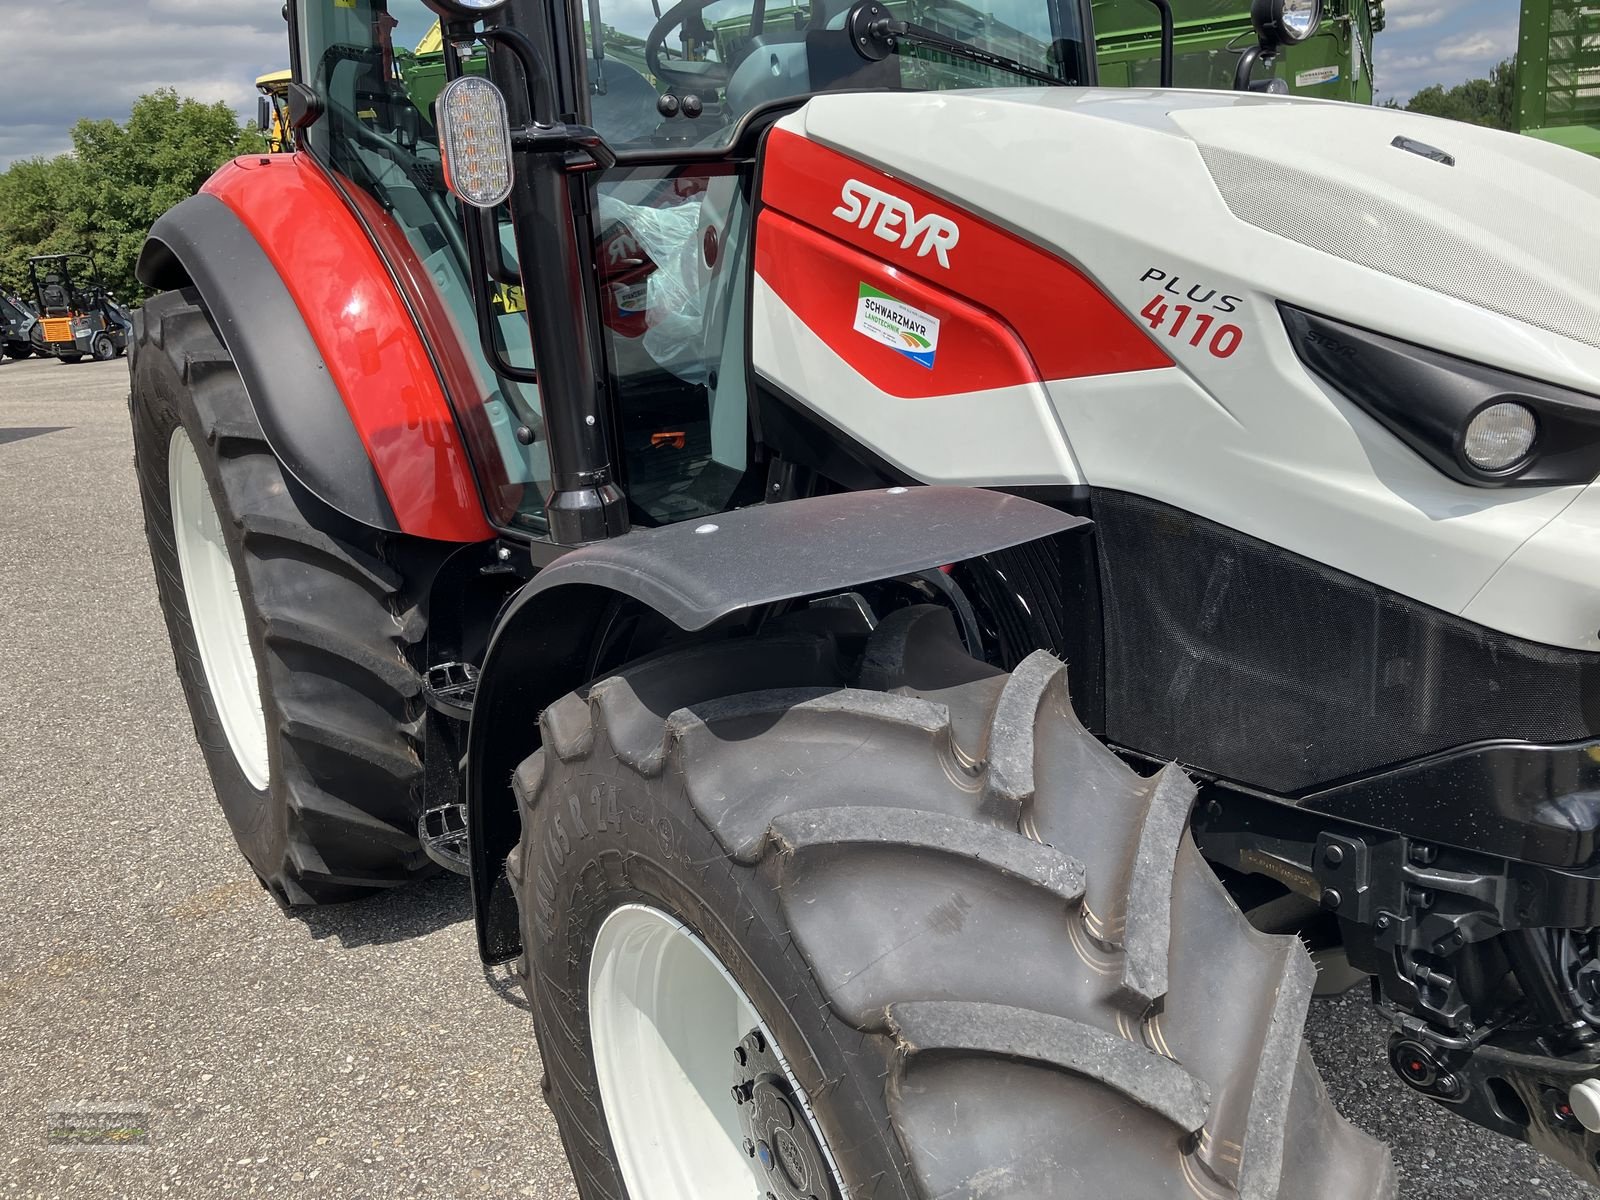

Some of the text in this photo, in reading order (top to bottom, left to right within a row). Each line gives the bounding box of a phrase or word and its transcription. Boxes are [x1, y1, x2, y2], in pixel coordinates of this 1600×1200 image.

[832, 178, 960, 270] STEYR
[1139, 267, 1244, 313] PLUS
[864, 298, 927, 337] SCHWARZMAYR
[864, 311, 901, 336] LANDTECHNIK
[1140, 294, 1244, 359] 4110
[1305, 330, 1358, 360] STEYR
